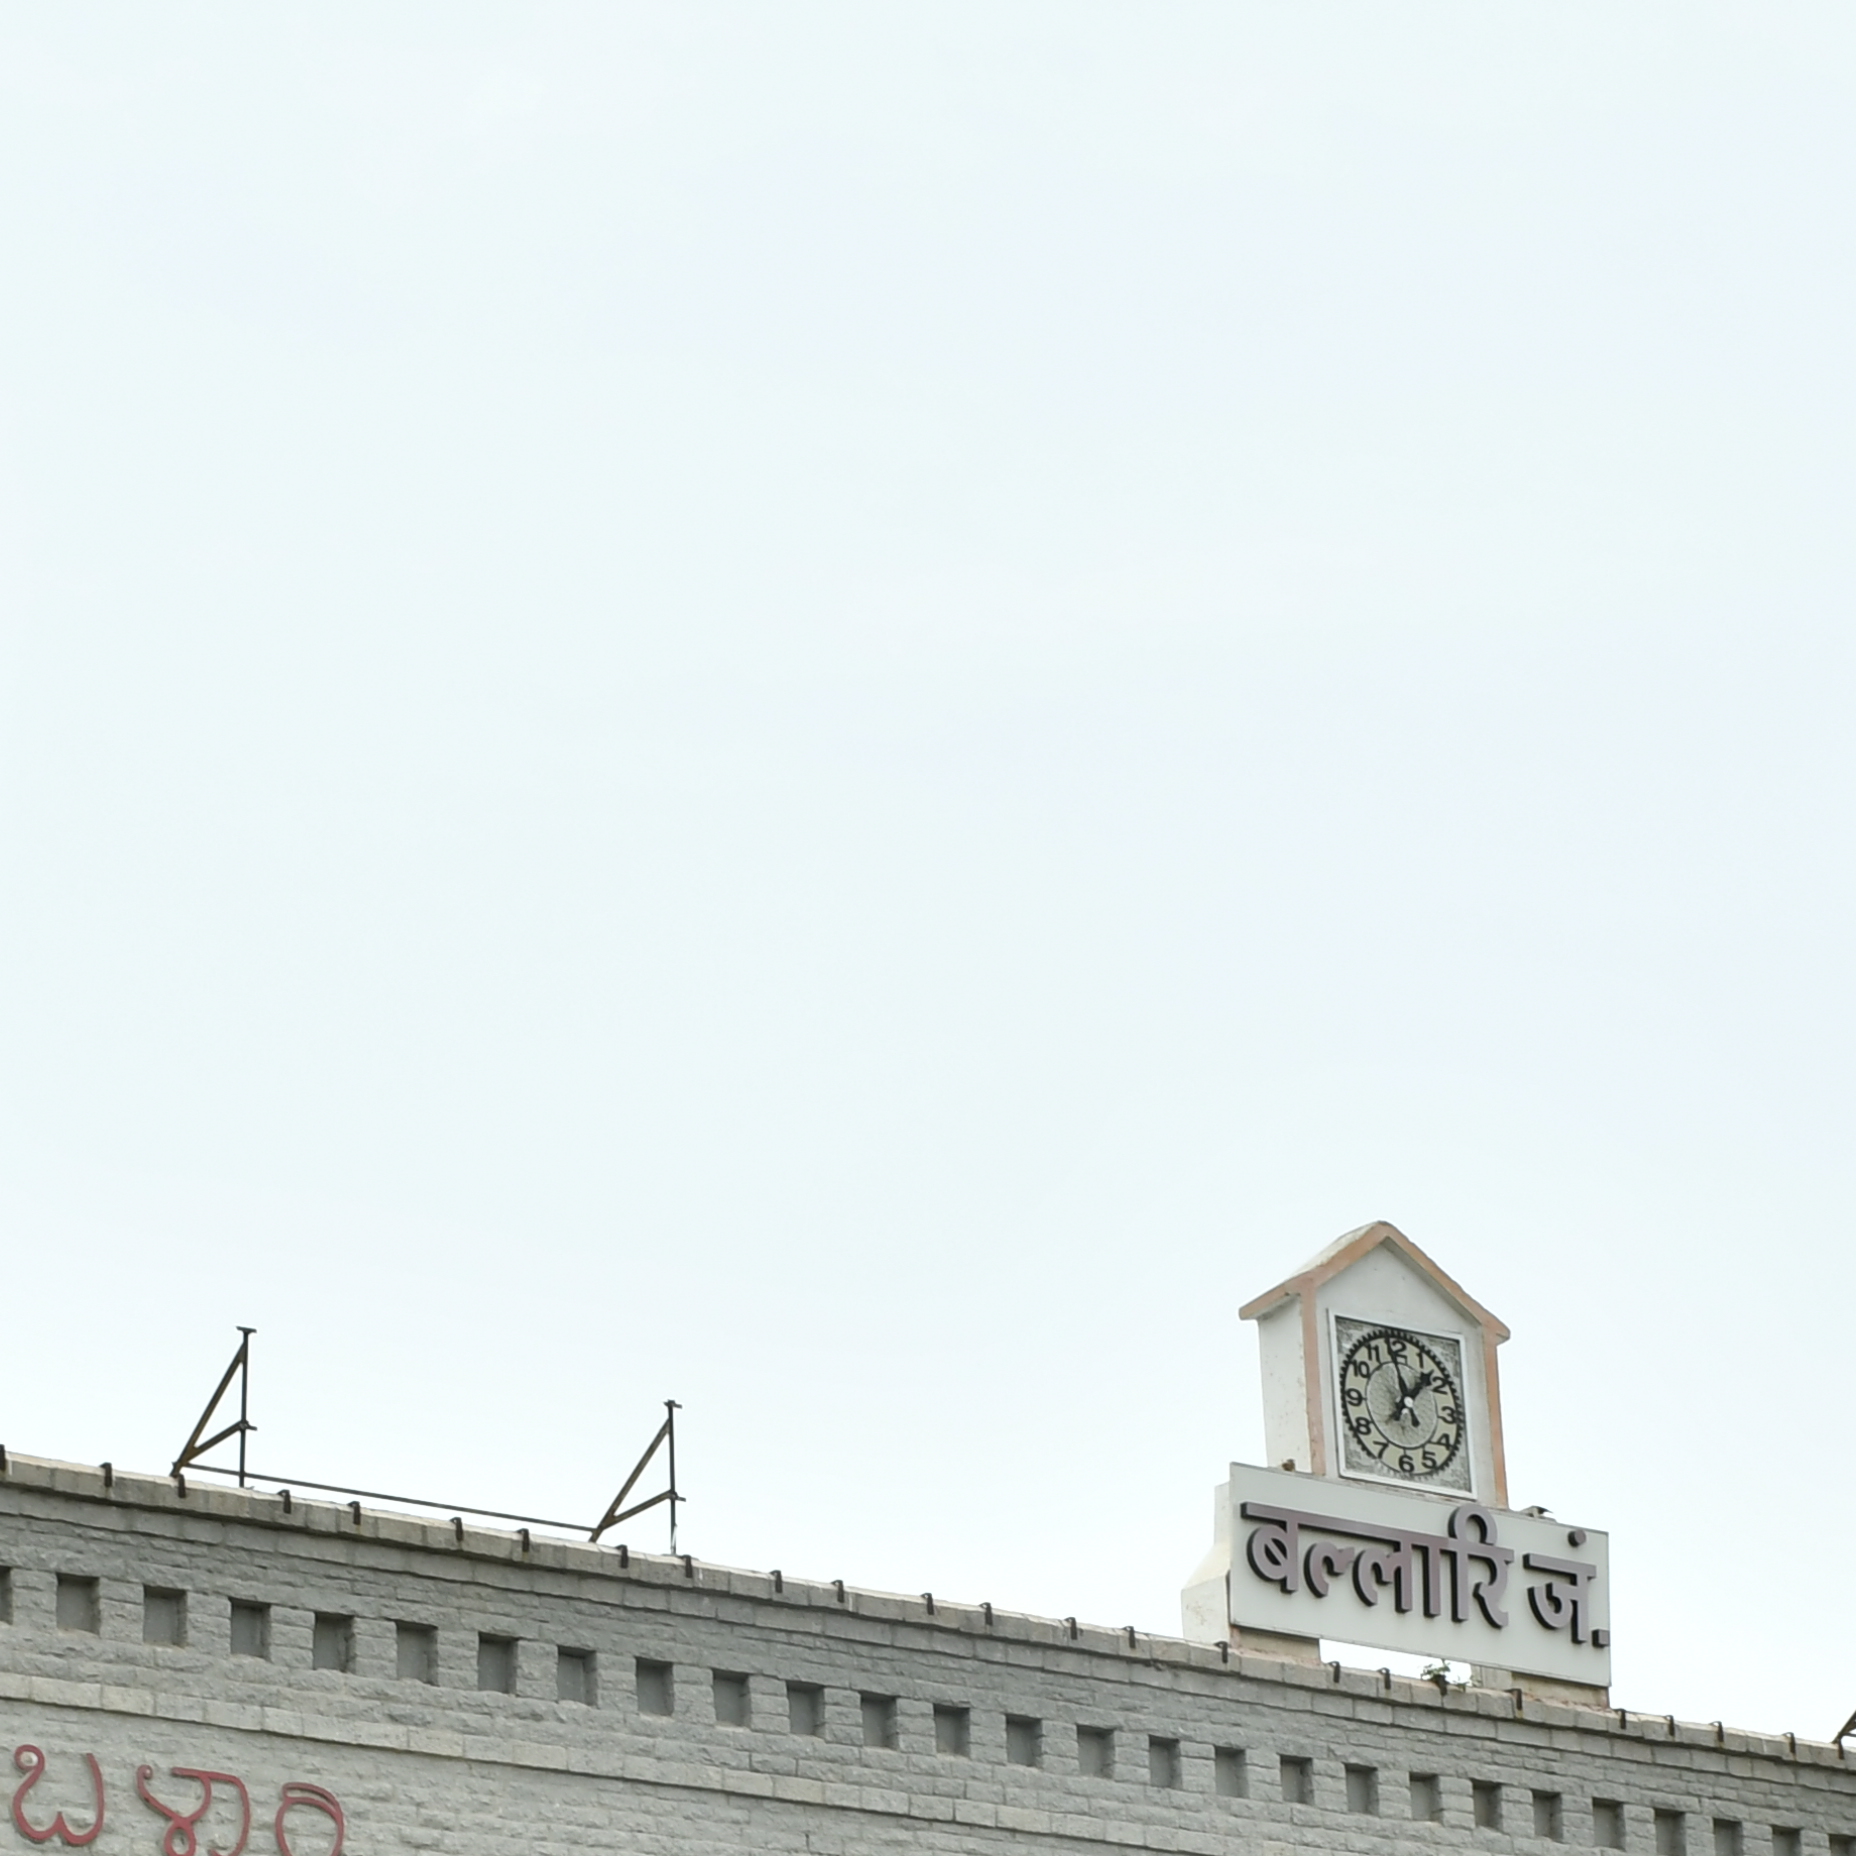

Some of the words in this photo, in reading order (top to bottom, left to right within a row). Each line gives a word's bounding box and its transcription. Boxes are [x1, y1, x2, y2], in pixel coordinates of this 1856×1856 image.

[1366, 1344, 1383, 1364] 11
[1351, 1360, 1370, 1378] 10
[1432, 1376, 1448, 1395] 2
[1346, 1388, 1363, 1406] 9
[1441, 1406, 1456, 1425] 3
[1356, 1417, 1372, 1435] 8
[1373, 1440, 1389, 1459] 7
[1431, 1433, 1451, 1451] 4
[1399, 1454, 1415, 1473] 6
[1422, 1451, 1437, 1469] 5
